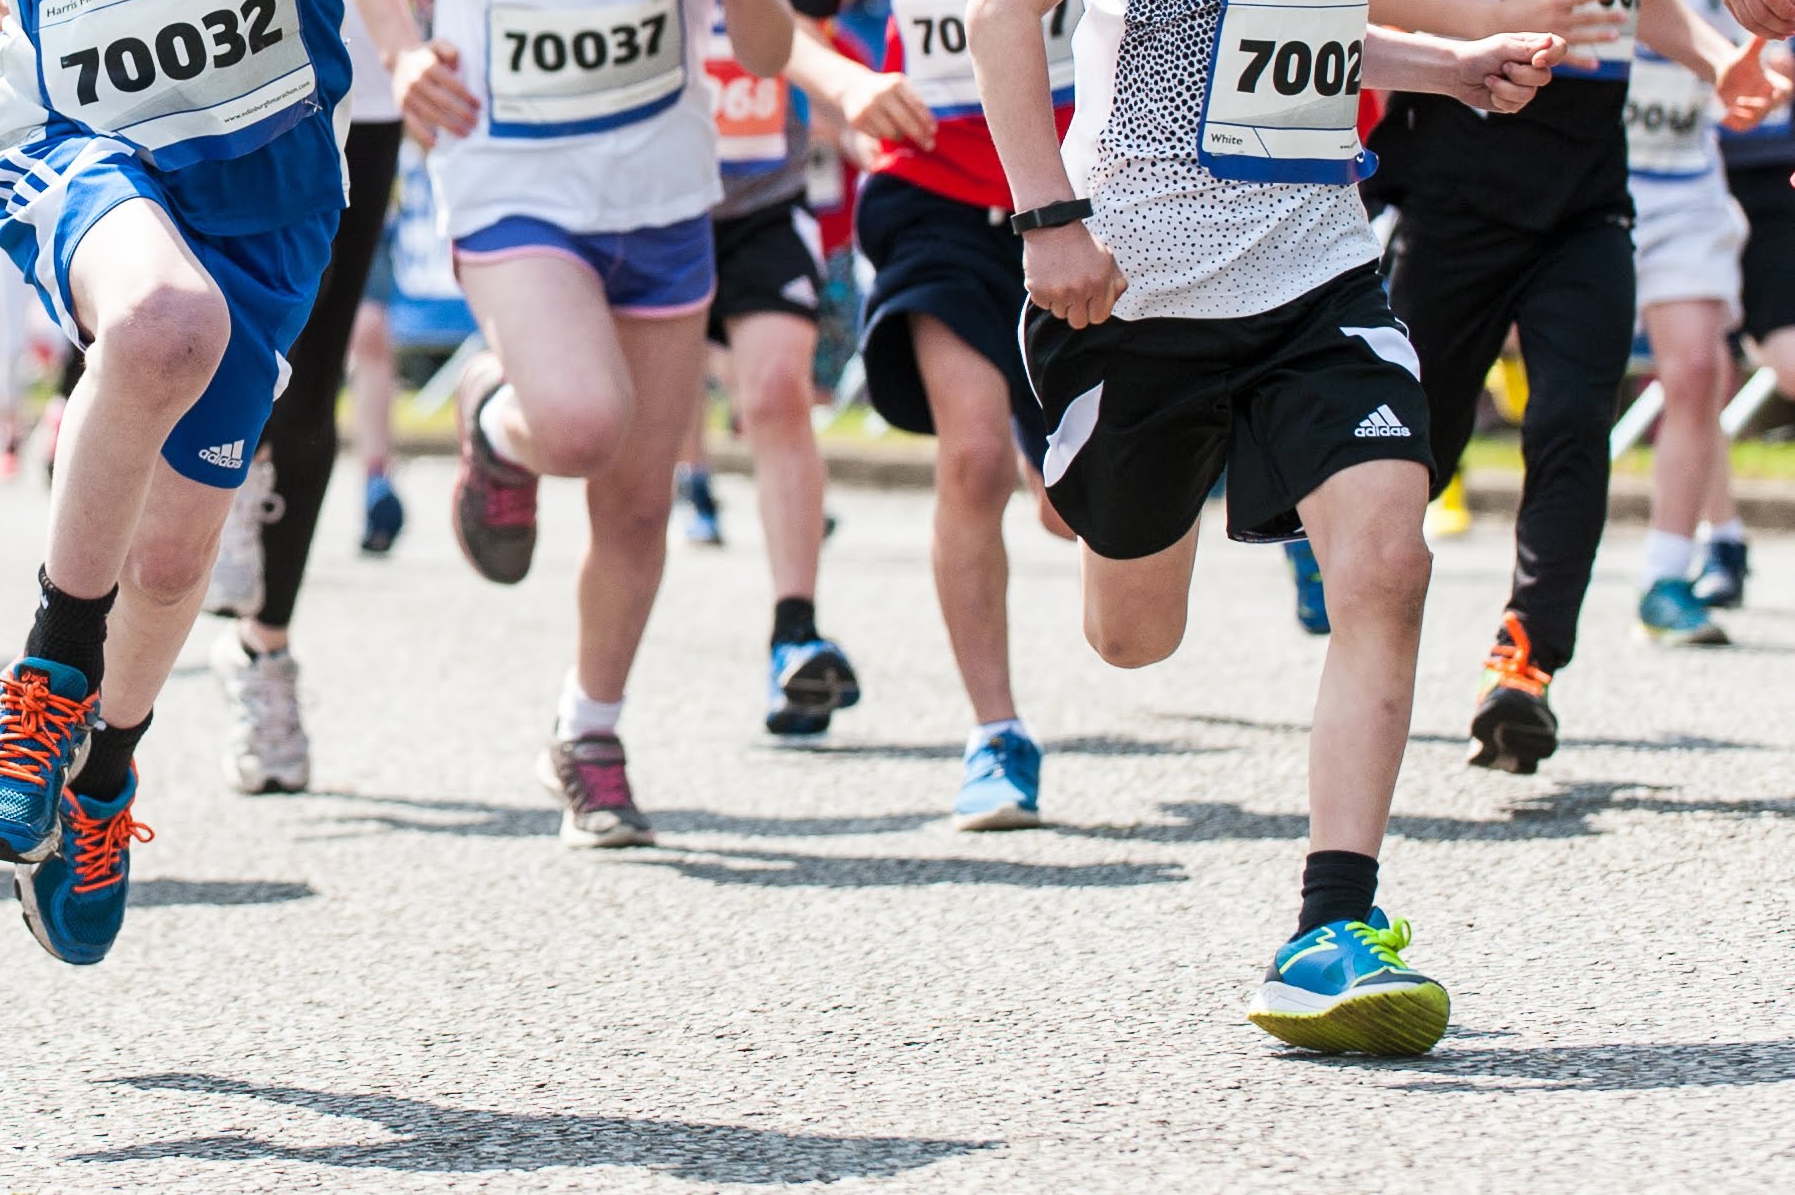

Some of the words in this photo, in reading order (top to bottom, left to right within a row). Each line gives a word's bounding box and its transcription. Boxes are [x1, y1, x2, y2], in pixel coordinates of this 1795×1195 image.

[46, 0, 78, 18] Harris
[506, 13, 666, 73] 70037
[1211, 133, 1244, 146] White
[1354, 426, 1411, 437] adidas
[198, 448, 244, 469] adidas
